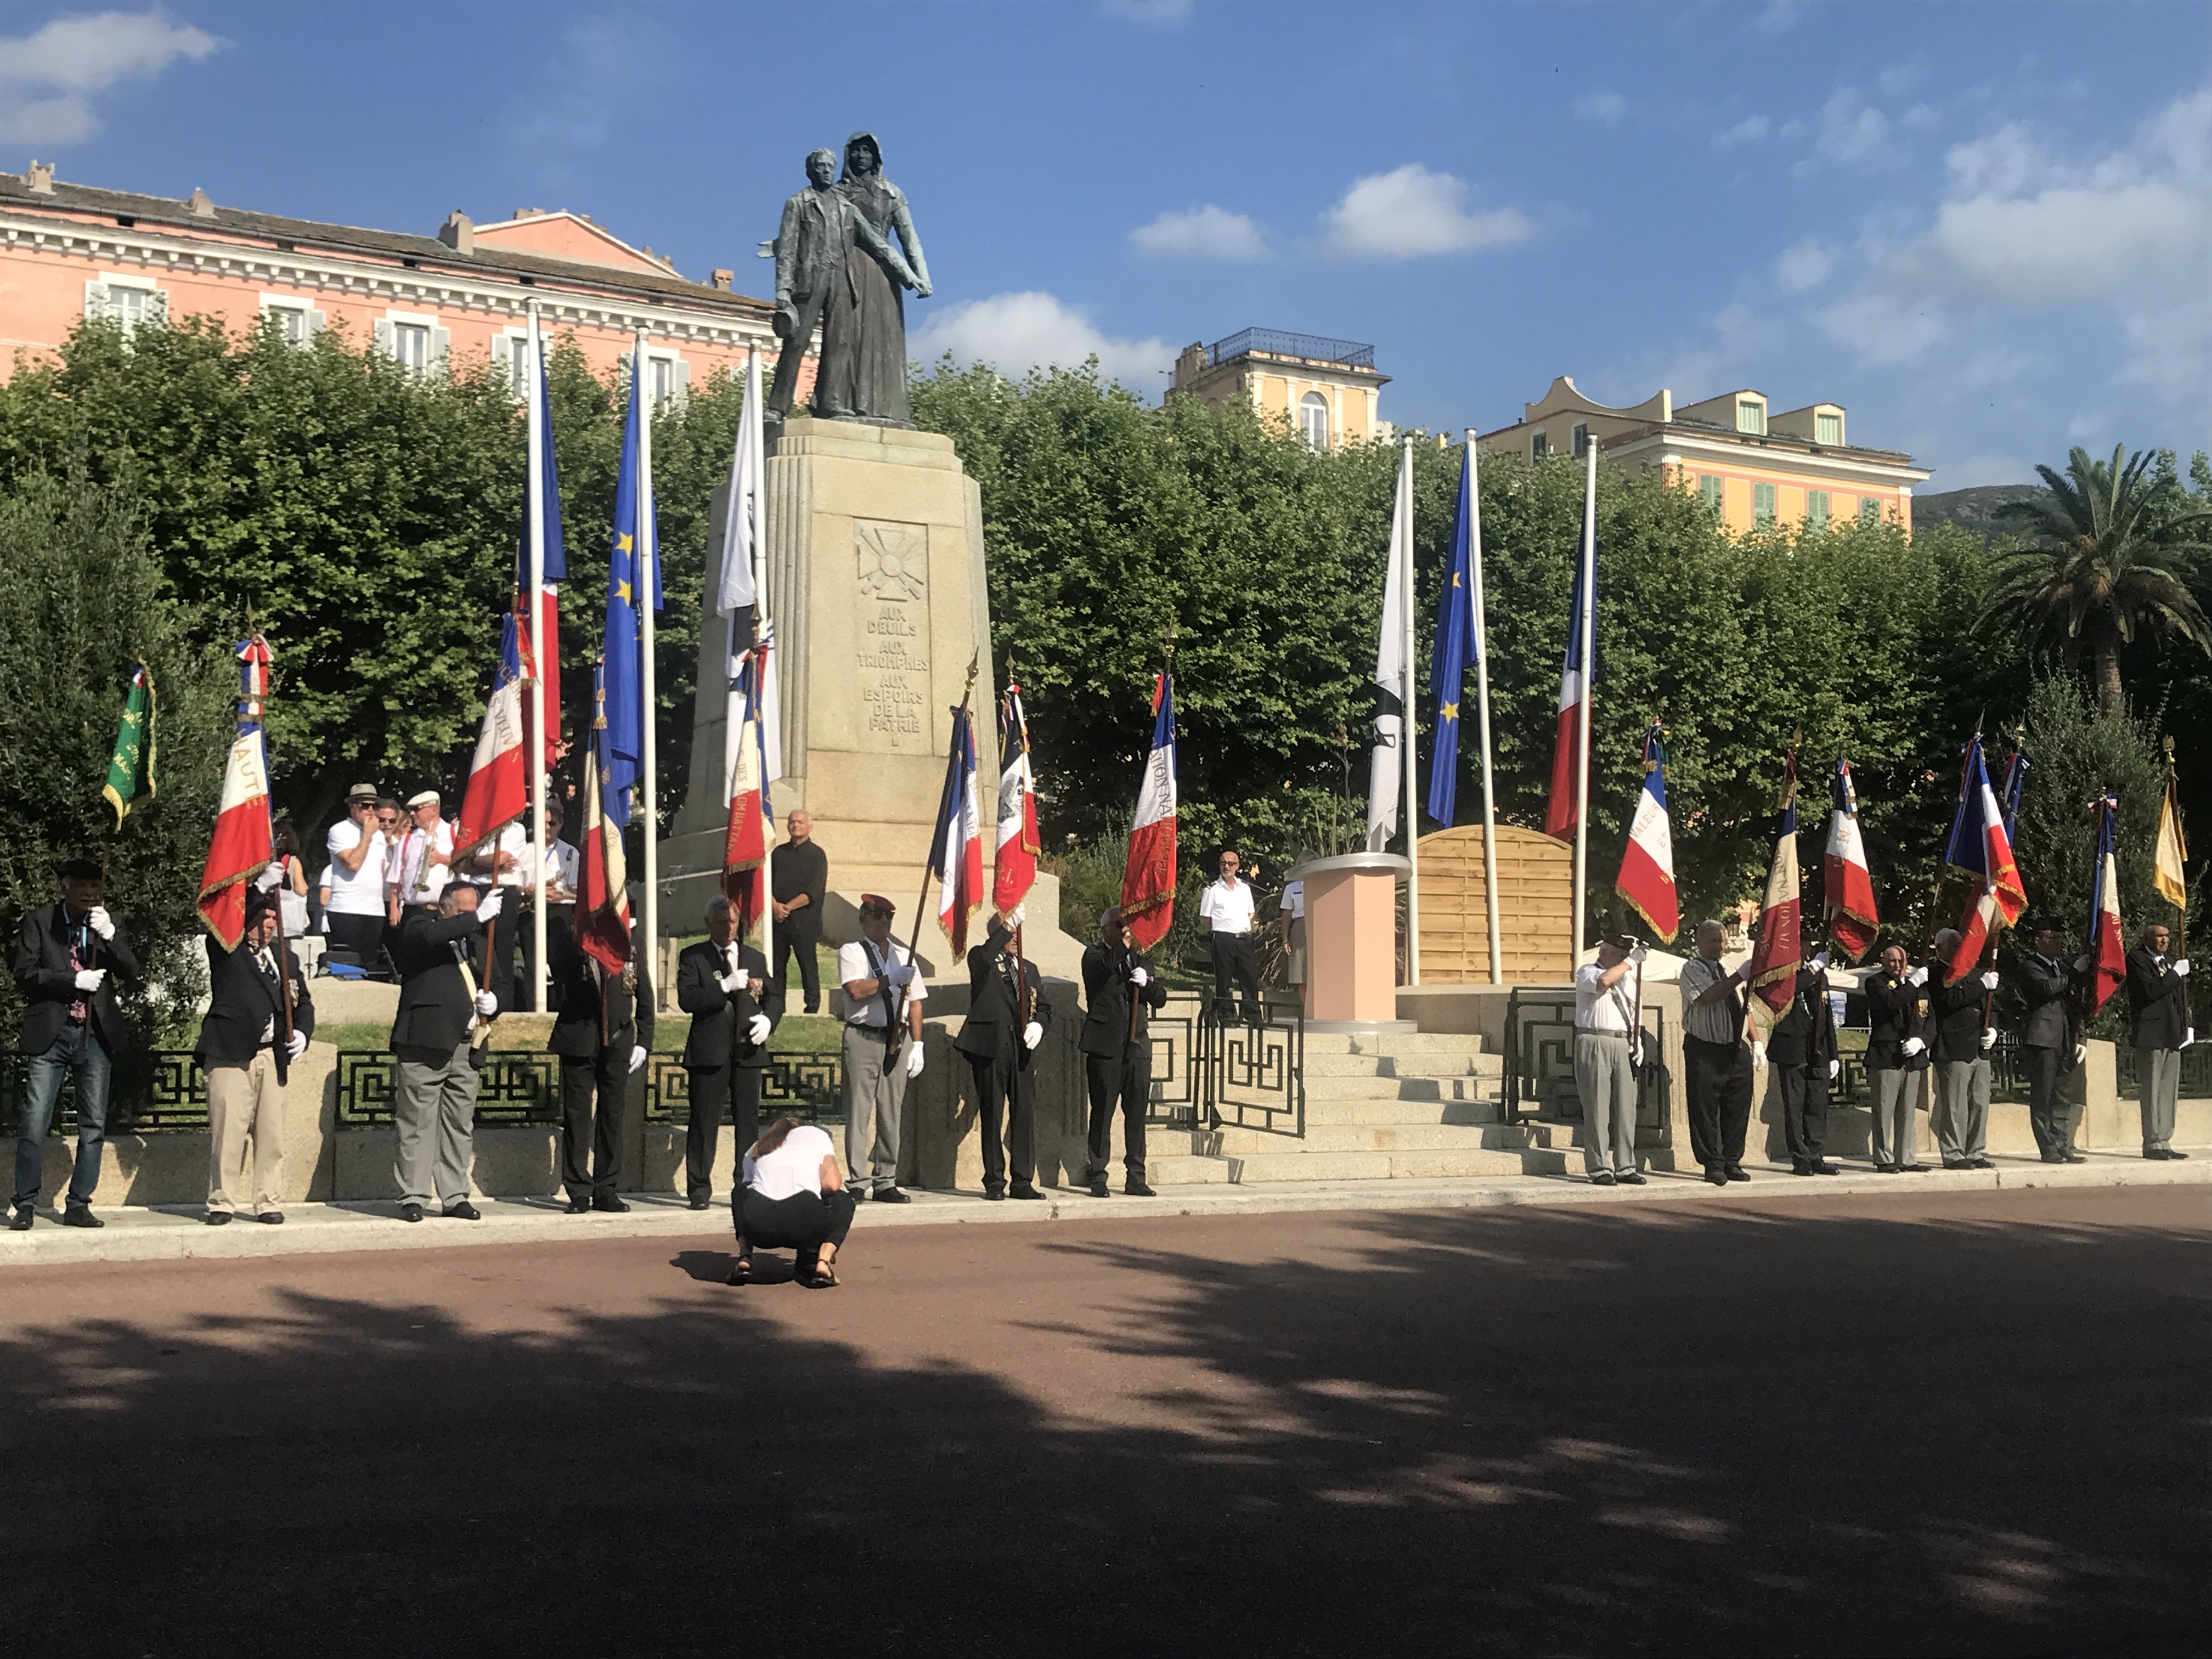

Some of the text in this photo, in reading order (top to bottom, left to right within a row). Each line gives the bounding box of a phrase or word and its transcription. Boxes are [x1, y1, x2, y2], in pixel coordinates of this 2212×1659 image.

[879, 606, 907, 622] AUX
[867, 619, 916, 637] DEUILS
[879, 640, 907, 656] AUX
[856, 652, 928, 672] TRIOMPHES
[880, 674, 909, 690] AUX
[863, 687, 923, 705] ESPOIRS
[873, 703, 917, 719] DE LA
[869, 717, 921, 734] PATRIE
[233, 728, 265, 810] HAUTE
[737, 763, 748, 783] DES
[1629, 803, 1661, 839] VALEUR
[1657, 832, 1669, 849] ET
